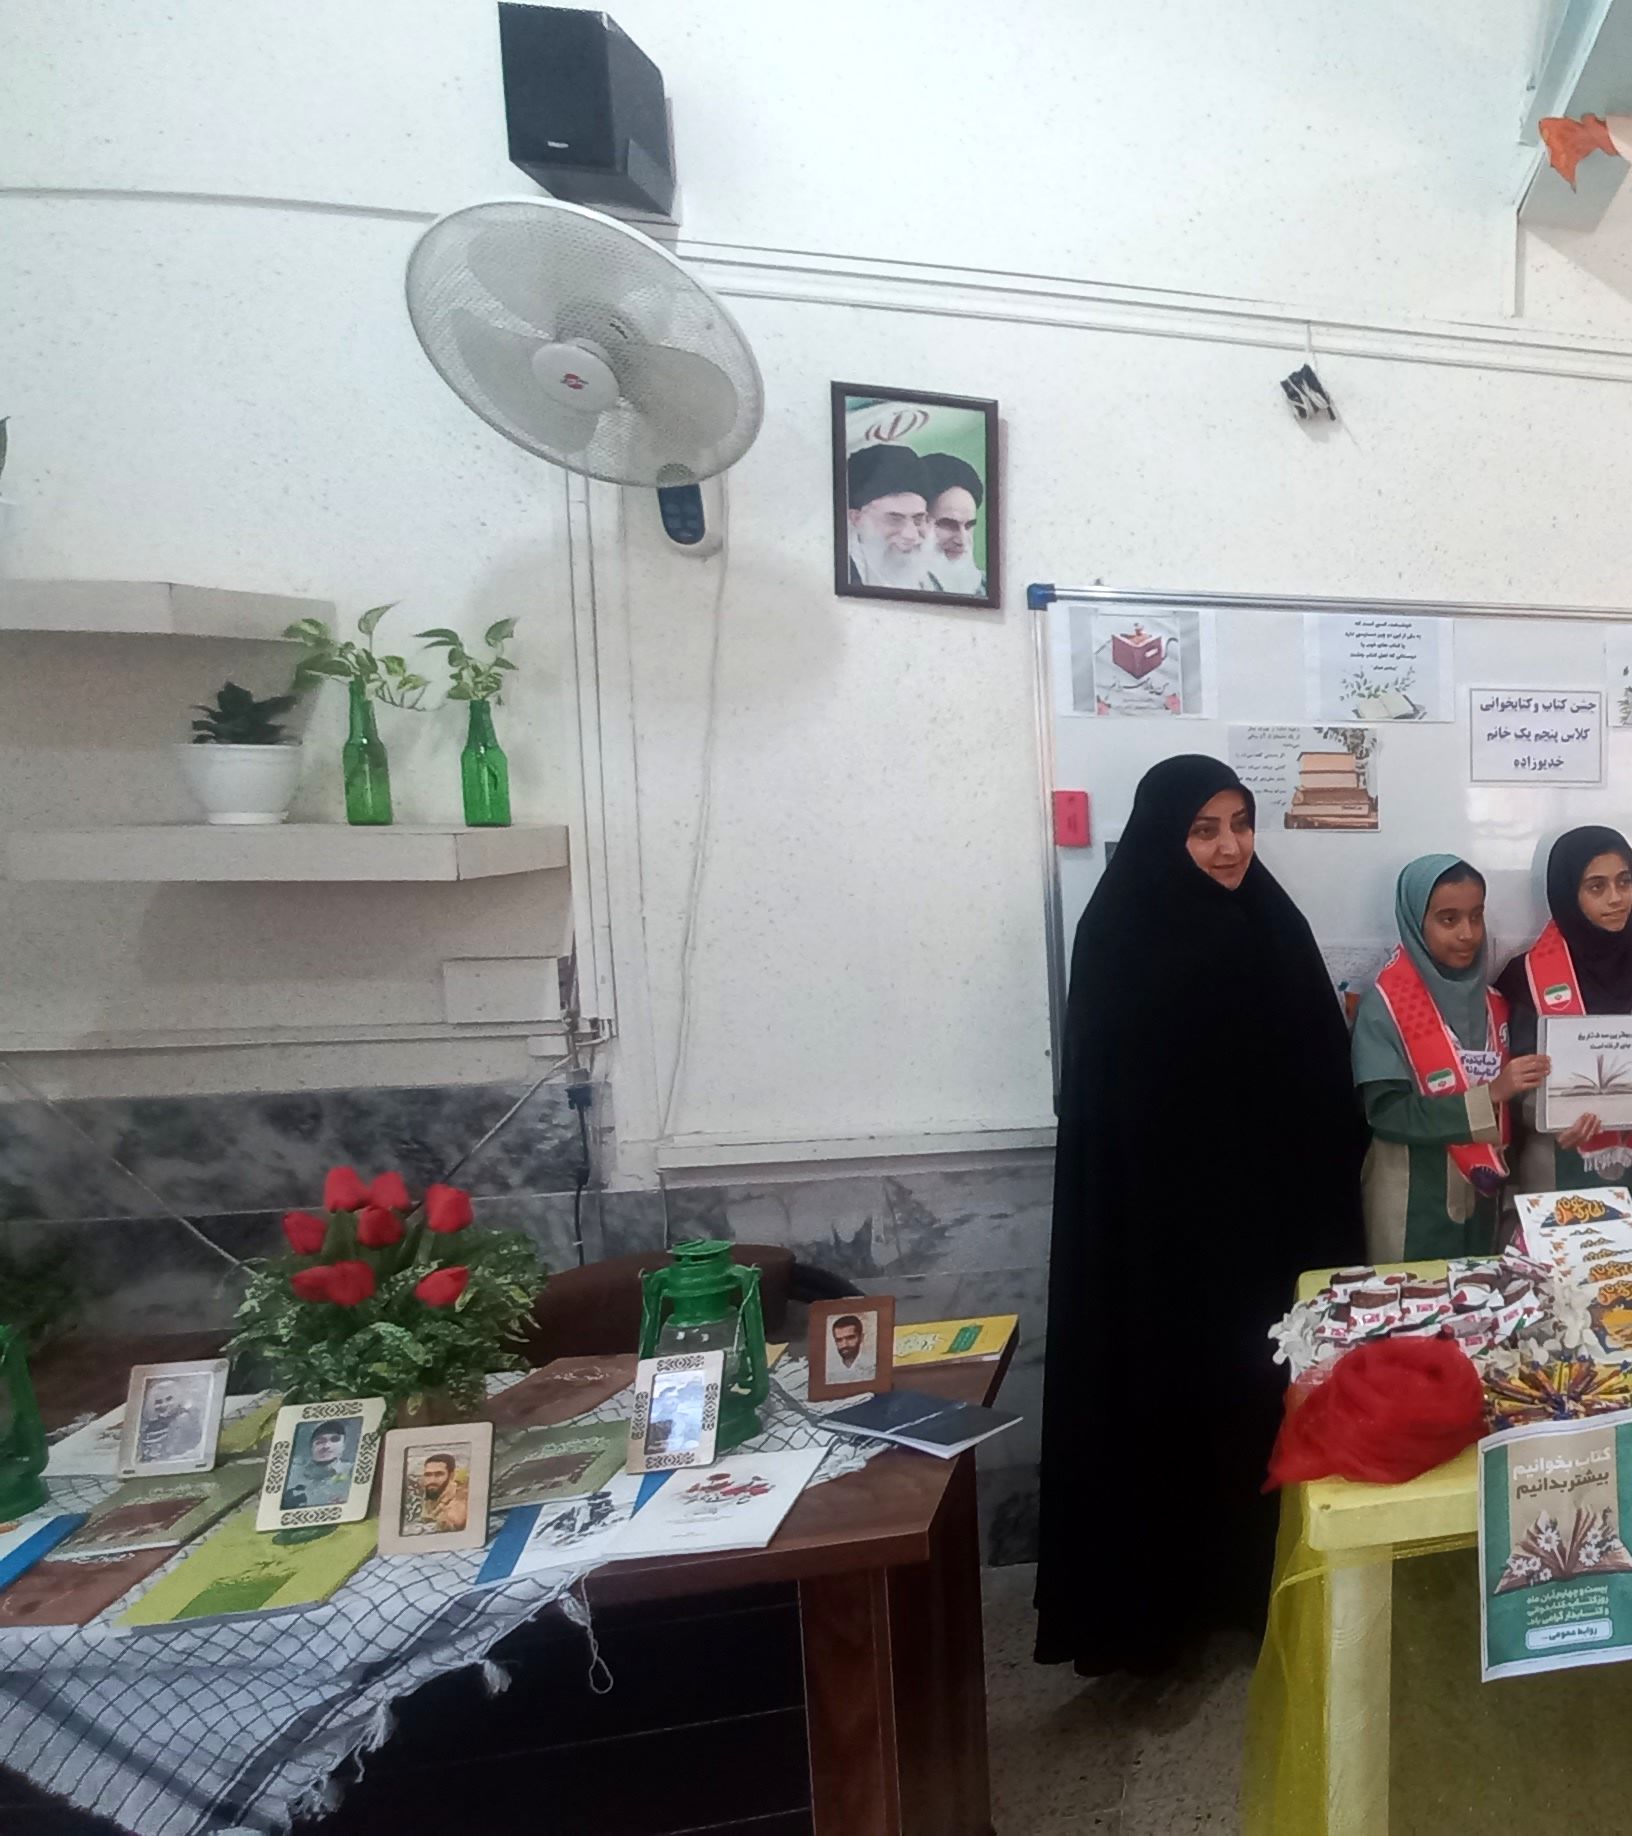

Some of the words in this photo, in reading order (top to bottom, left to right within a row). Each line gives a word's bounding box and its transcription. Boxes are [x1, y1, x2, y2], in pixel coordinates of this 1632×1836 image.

[1542, 698, 1568, 712] کتاب
[1570, 699, 1597, 713] جشن
[1487, 726, 1512, 741] خانم
[1514, 727, 1532, 742] یک
[1534, 728, 1559, 743] پنجم
[1561, 728, 1591, 742] کلاس
[1574, 1448, 1612, 1470] کتاب
[1513, 1455, 1573, 1480] بخوانیم
[1516, 1476, 1568, 1500] بدانیم
[1568, 1470, 1610, 1491] بیشتر
